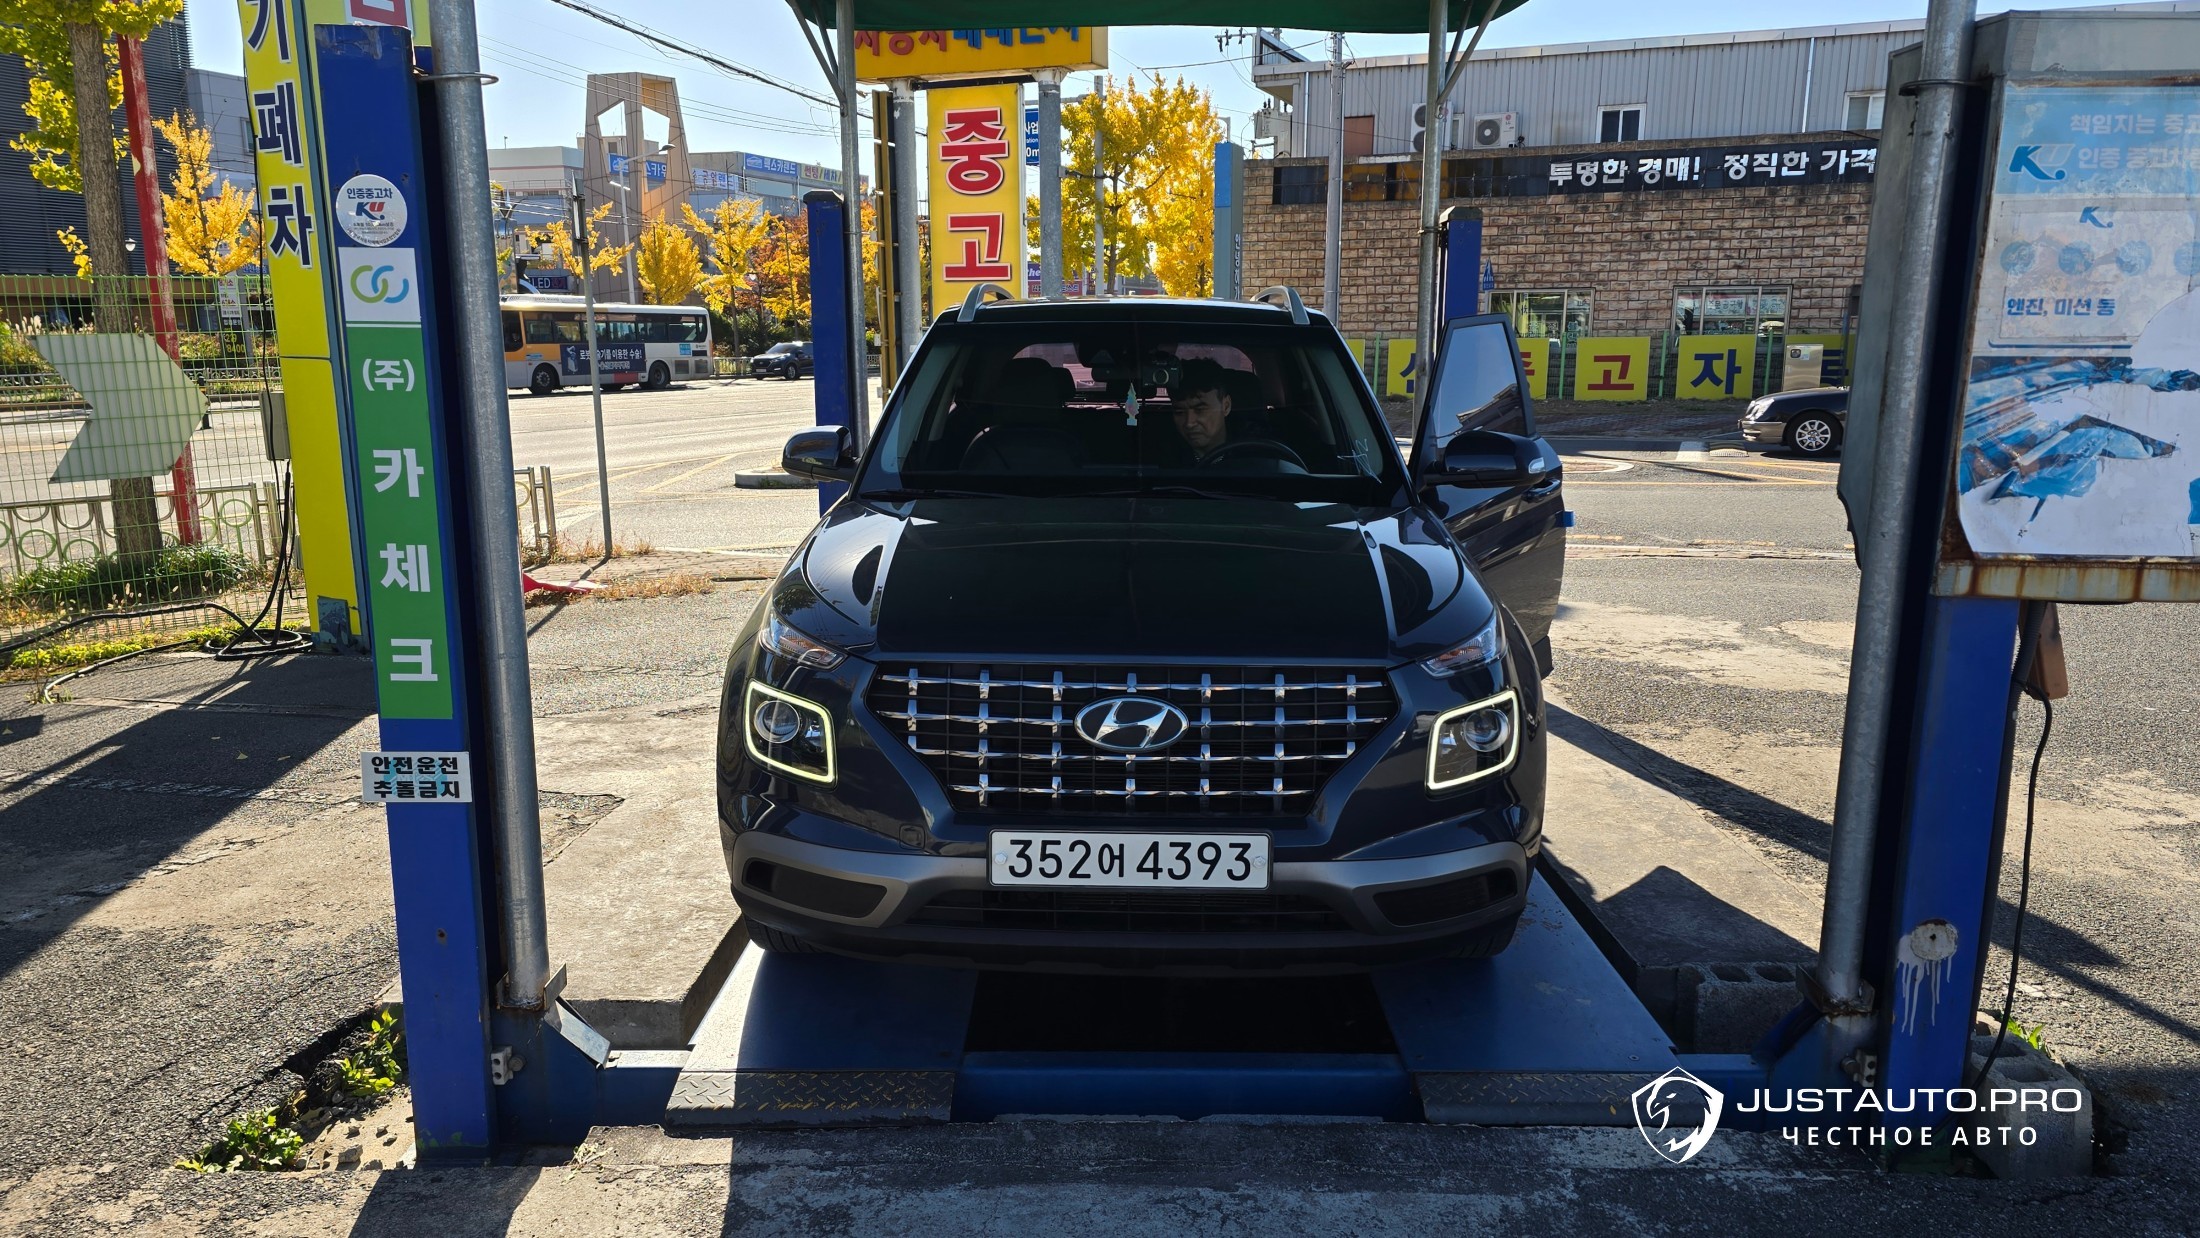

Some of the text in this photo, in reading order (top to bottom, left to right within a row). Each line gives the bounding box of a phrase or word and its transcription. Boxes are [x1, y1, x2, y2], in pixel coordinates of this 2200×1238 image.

[2070, 114, 2156, 134] 책임지는
[1550, 148, 1877, 187] 투명한 경매! 정직한 가격
[2078, 148, 2121, 169] 인증
[346, 187, 393, 199] 인증중고차
[940, 107, 1012, 281] 중고
[2007, 298, 2048, 316] 엔진,
[2054, 298, 2093, 316] 미션
[371, 756, 459, 775] 안전운전
[373, 780, 460, 799] 추돌금지
[1008, 839, 1252, 881] 352어 4393
